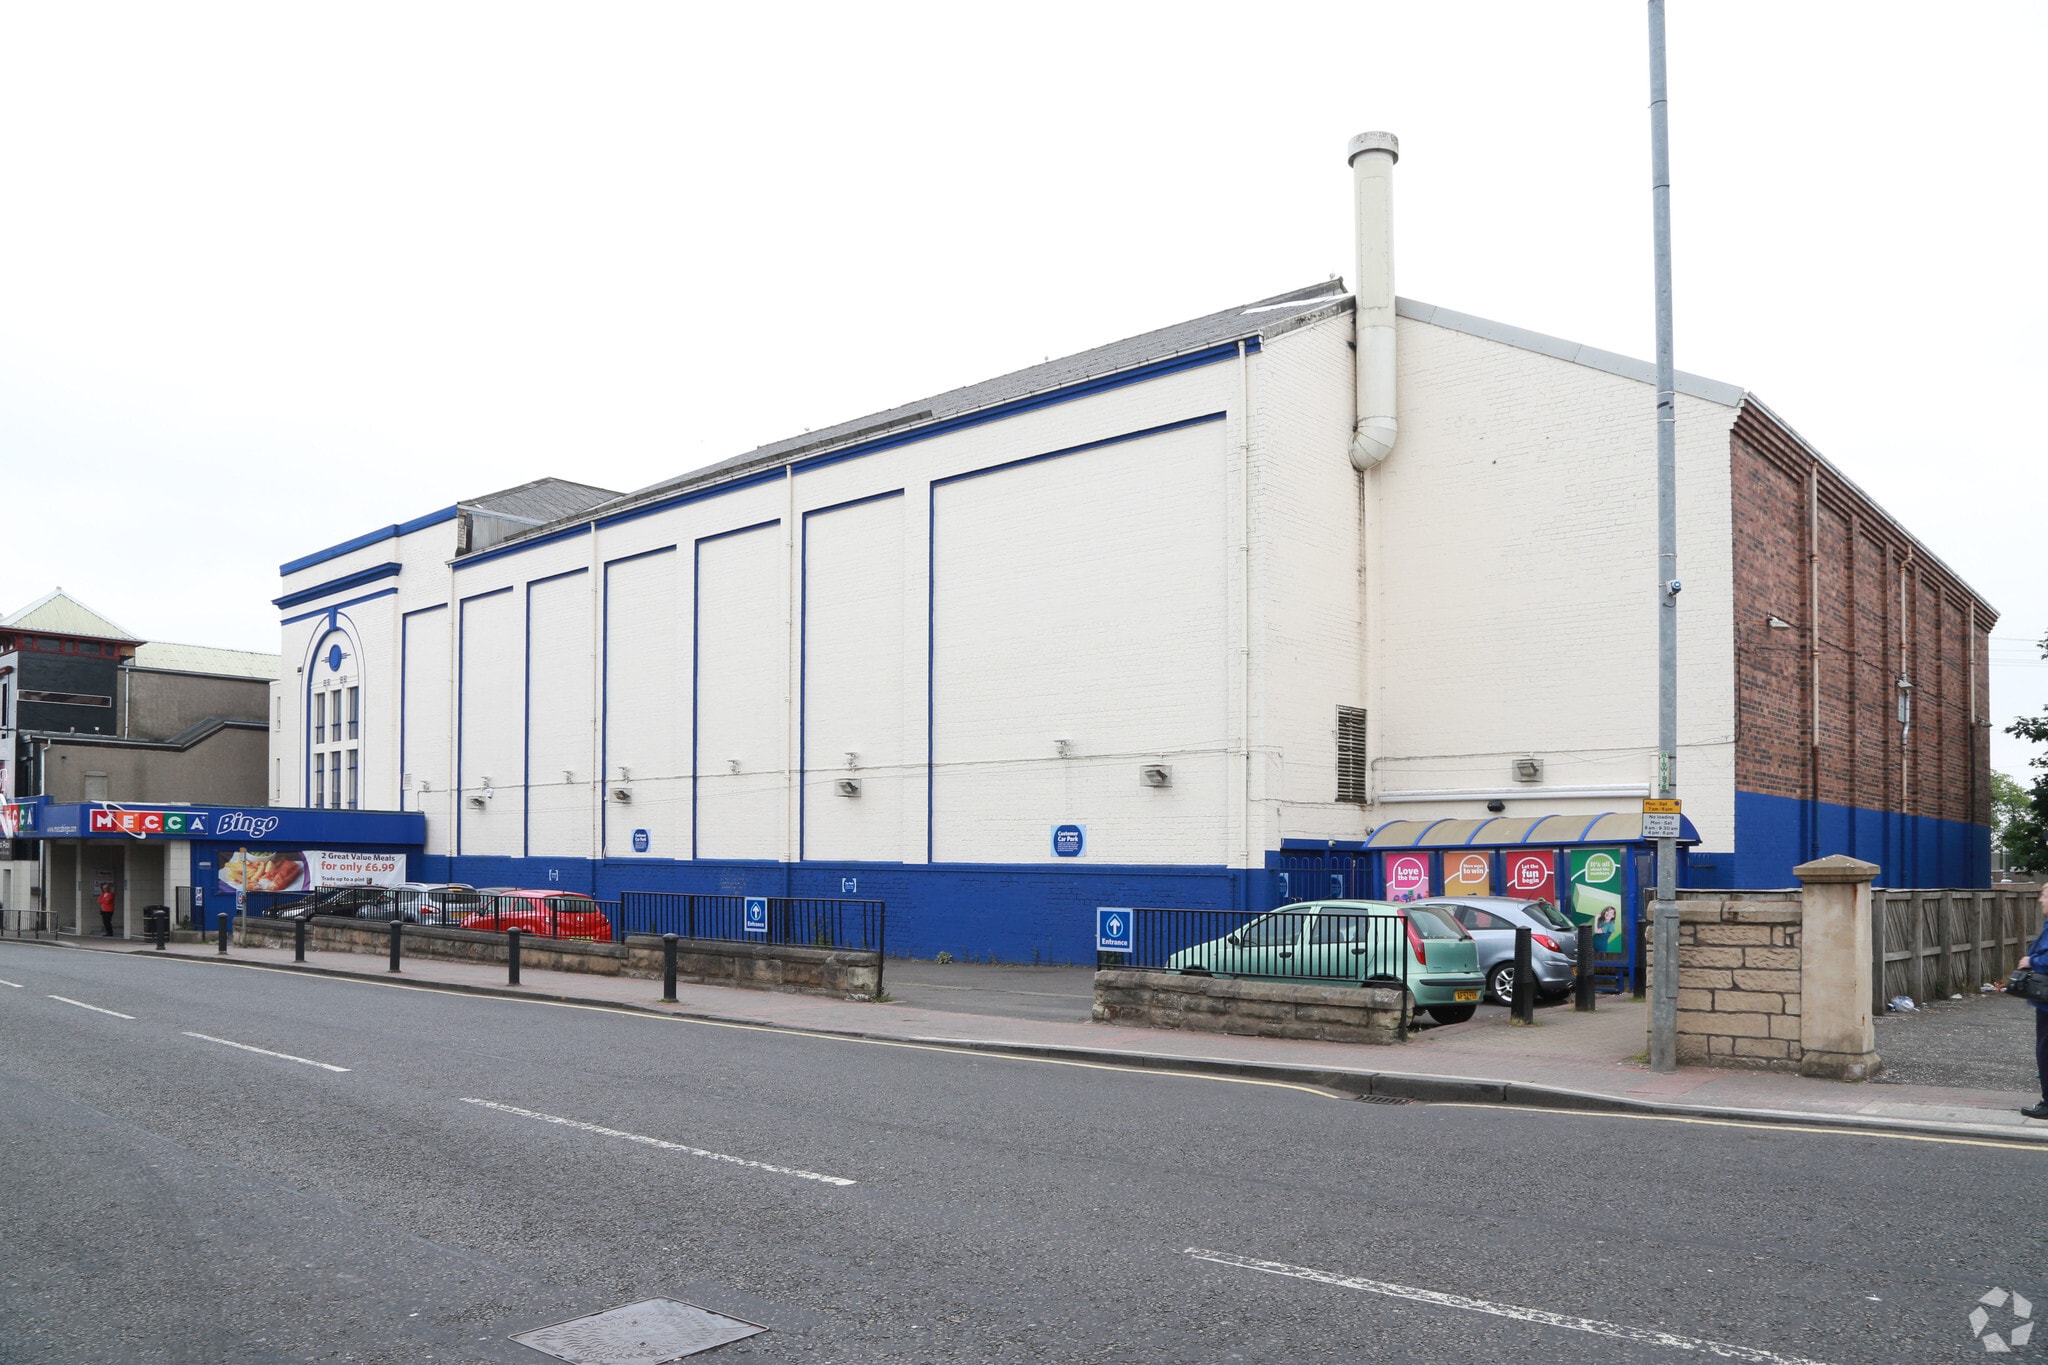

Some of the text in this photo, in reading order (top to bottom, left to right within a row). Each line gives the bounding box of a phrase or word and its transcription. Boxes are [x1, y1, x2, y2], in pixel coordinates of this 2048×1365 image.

[96, 812, 279, 838] MECCA Bingo
[321, 861, 395, 873] for only £6.99
[1398, 867, 1419, 875] Love
[1522, 869, 1539, 878] fun
